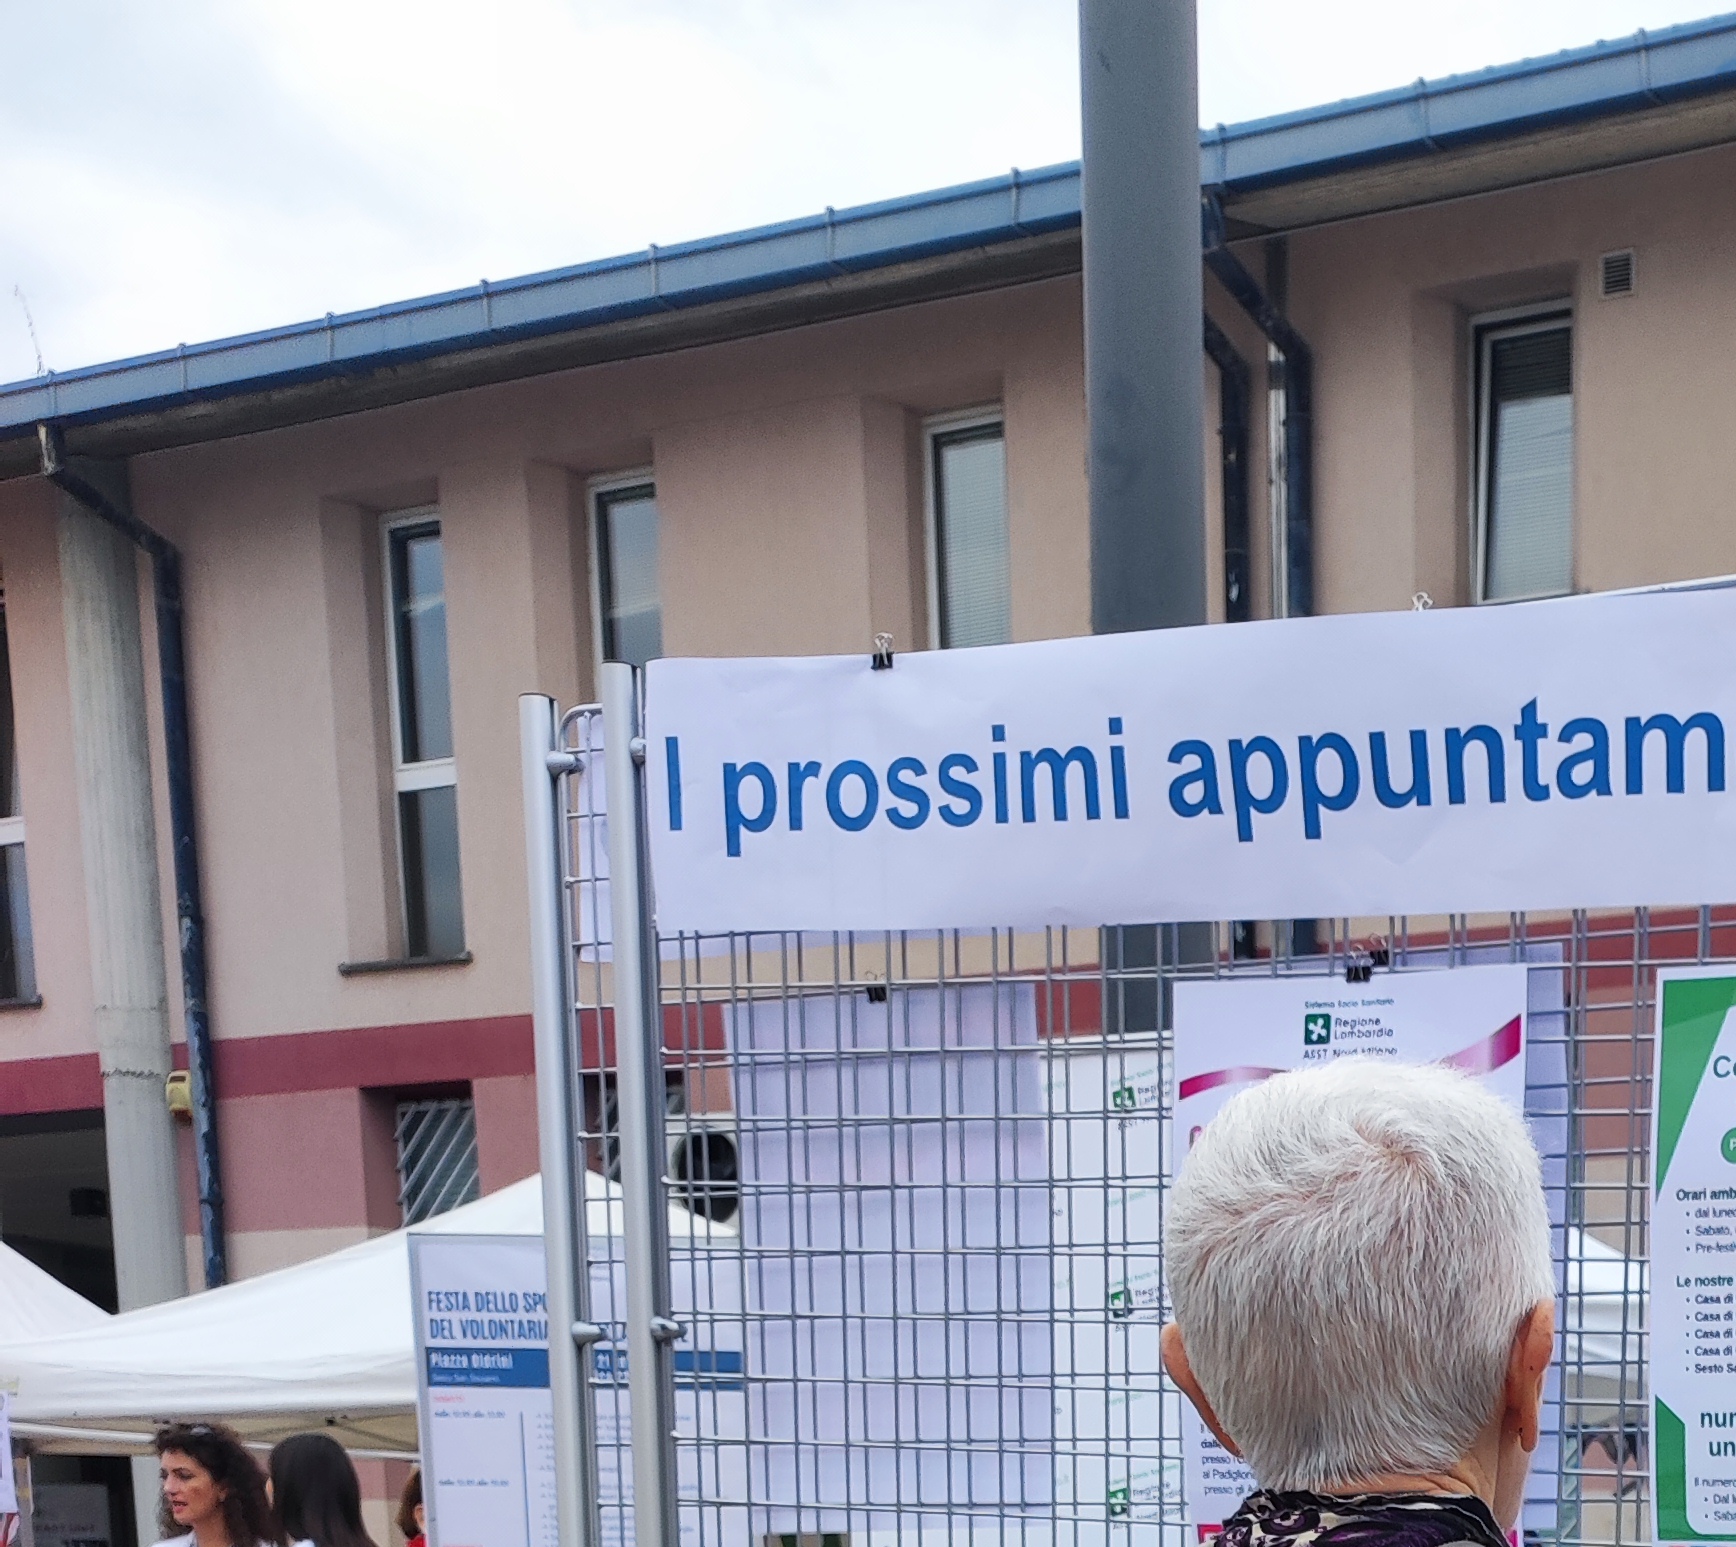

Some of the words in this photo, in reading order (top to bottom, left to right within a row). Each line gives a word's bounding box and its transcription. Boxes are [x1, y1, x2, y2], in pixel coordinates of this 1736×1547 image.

[664, 736, 682, 830] I
[722, 716, 1129, 857] prossimi
[1675, 1187, 1706, 1201] Orari
[1676, 1275, 1691, 1287] Le
[1694, 1275, 1733, 1287] nostre
